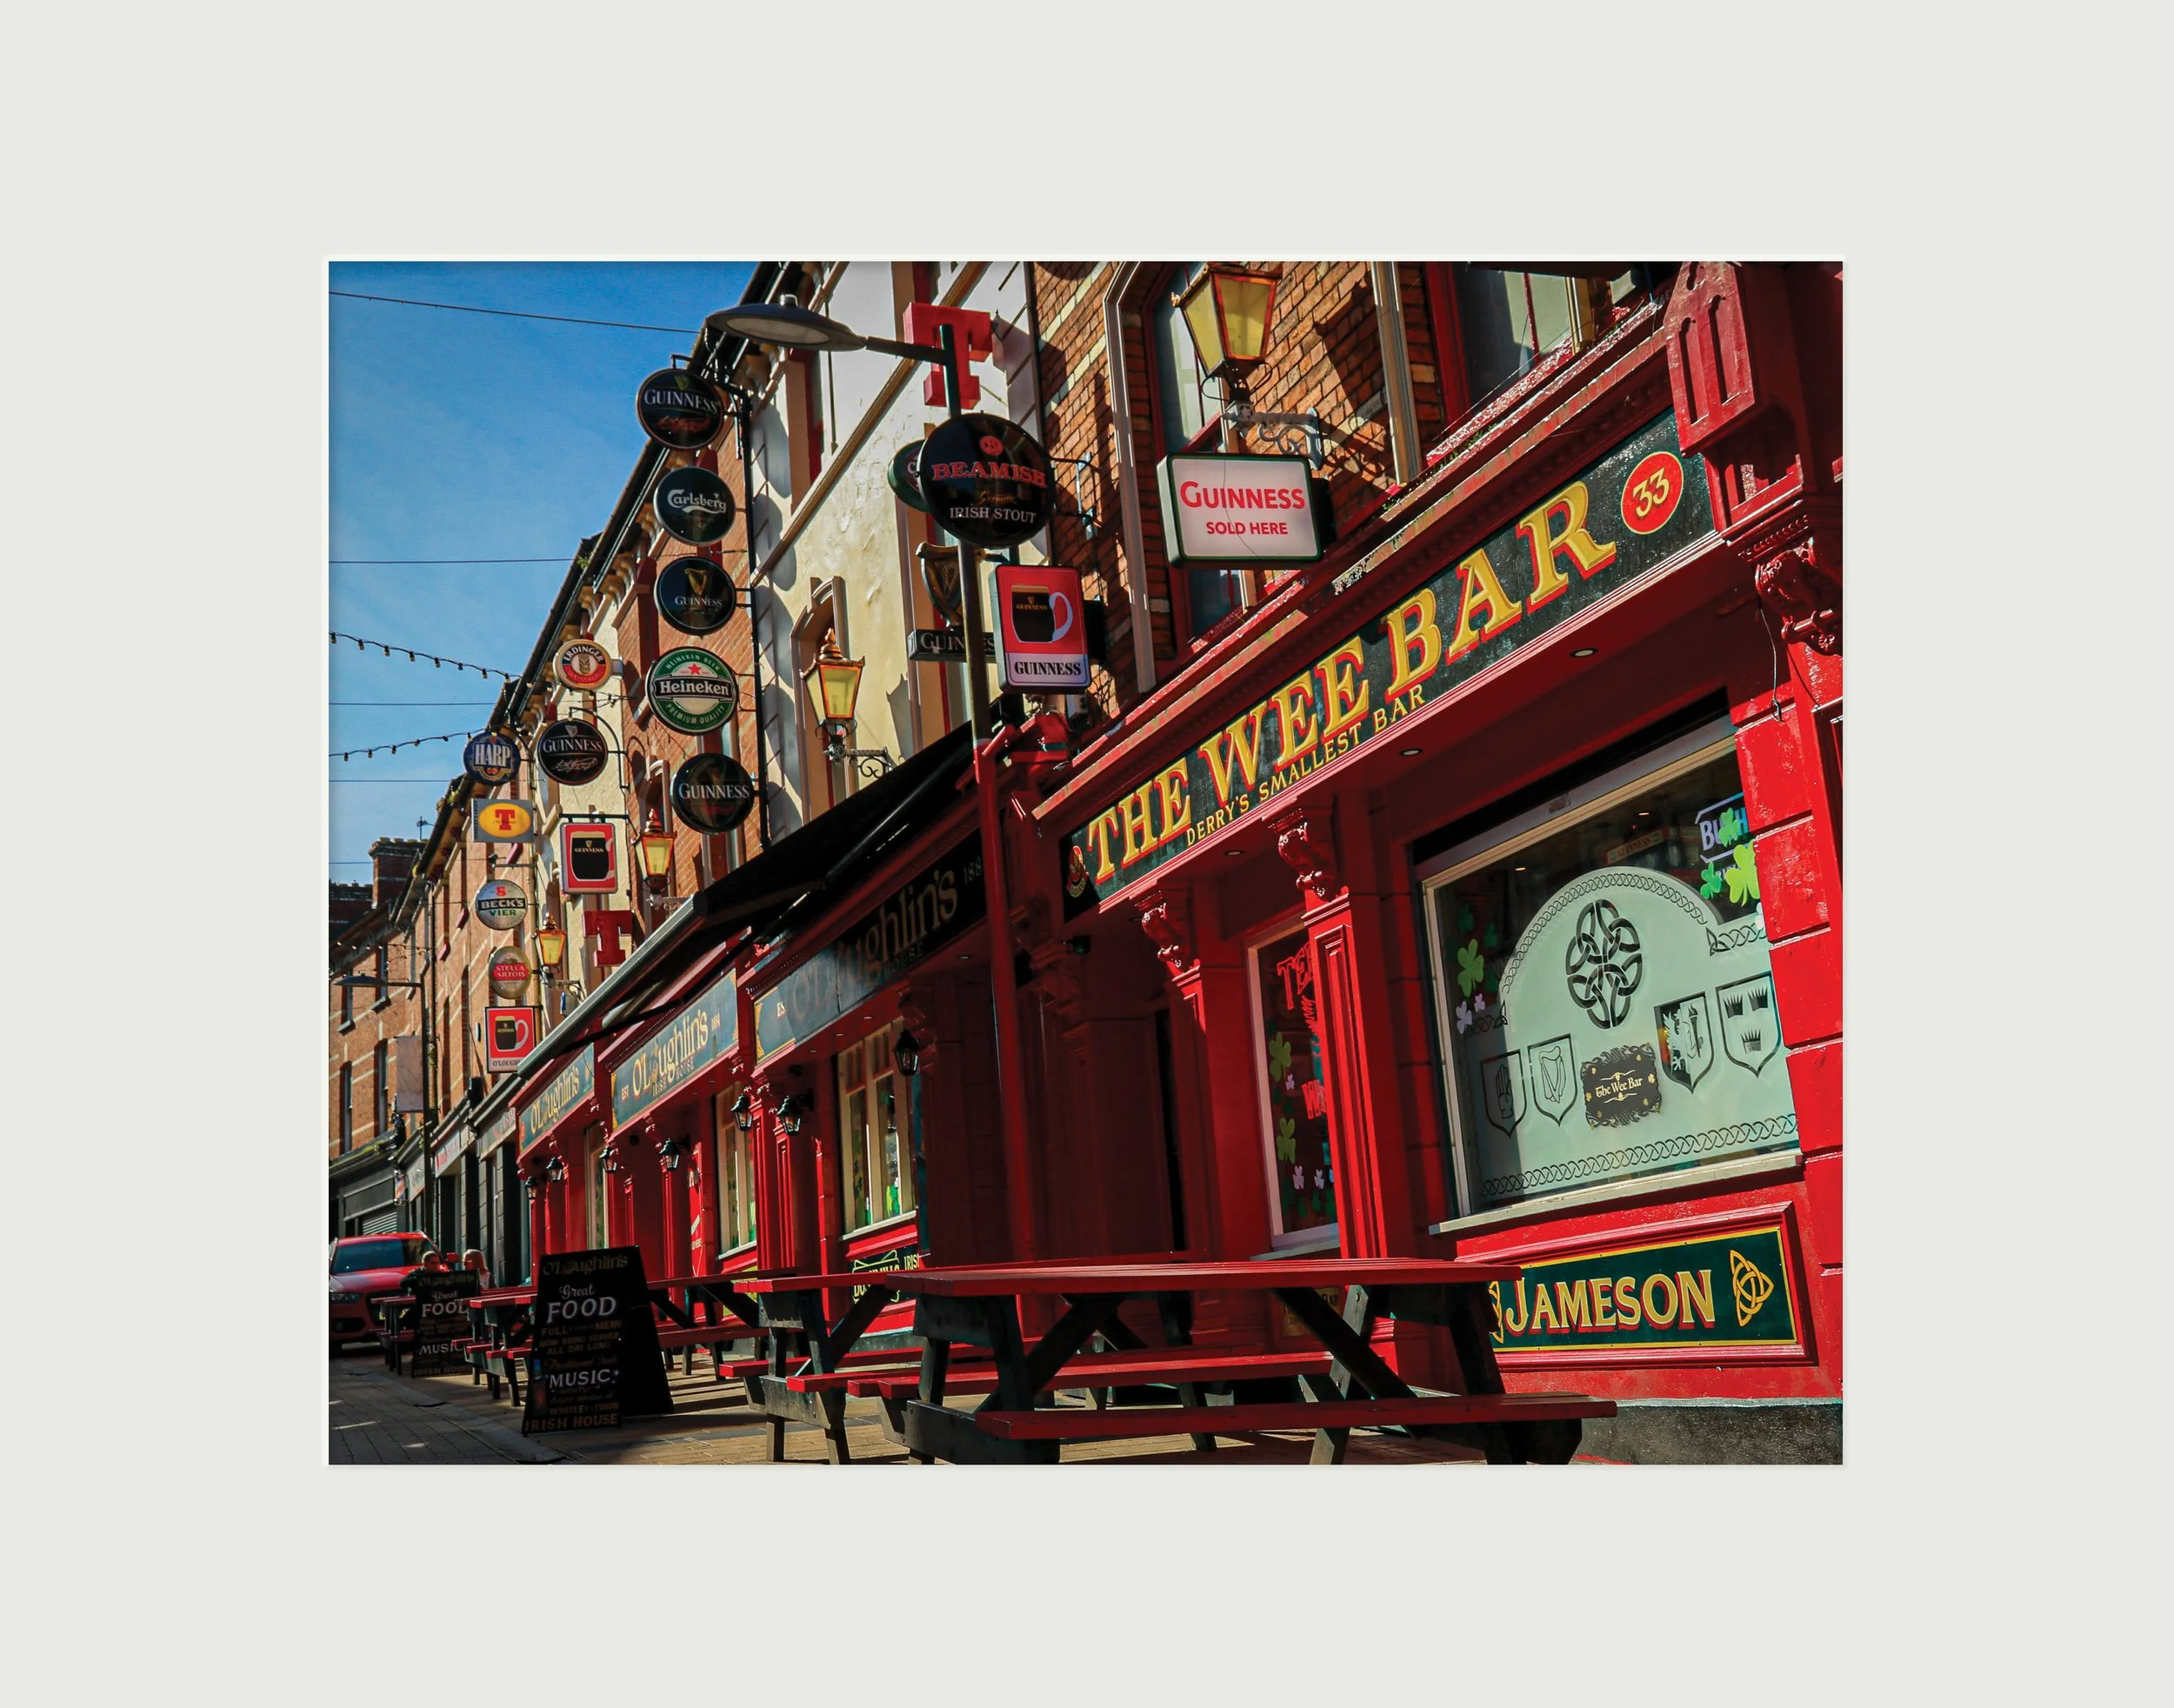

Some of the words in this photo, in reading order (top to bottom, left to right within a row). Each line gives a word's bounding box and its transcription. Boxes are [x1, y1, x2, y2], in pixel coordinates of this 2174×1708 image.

[644, 389, 718, 415] GUINNESS
[931, 461, 1047, 489] BEAMISH
[667, 489, 727, 514] Carlsberg
[1180, 481, 1305, 510] GUINNESS
[1631, 467, 1671, 518] 33
[949, 506, 990, 519] IRISH
[993, 508, 1037, 524] STOUT
[1206, 522, 1246, 535] SOLD
[1250, 522, 1288, 535] HERE
[675, 596, 723, 607] GUINNESS
[666, 654, 700, 670] HEINEKEN
[1014, 661, 1082, 677] GUINNESS
[659, 680, 729, 696] Heineken
[1087, 757, 1192, 885] THE
[1197, 635, 1370, 807] WEE
[1380, 480, 1617, 704] BAR
[665, 704, 697, 724] PREMIUM
[699, 705, 725, 724] QUALITY
[475, 744, 510, 766] HARP
[543, 739, 603, 753] GUINNESS
[1186, 793, 1250, 847] DERRY'S
[1259, 722, 1362, 802] SMALLEST
[1373, 684, 1425, 733] BAR
[678, 783, 750, 799] GUINNESS
[495, 810, 516, 831] T
[964, 857, 982, 885] 188
[481, 898, 523, 910] BECK'S
[1595, 1084, 1610, 1098] The
[1610, 1081, 1628, 1093] Wee
[1628, 1077, 1644, 1089] Bar
[559, 1283, 596, 1299] Great
[546, 1297, 617, 1324] FOOD
[1504, 1269, 1716, 1338] JAMESON
[549, 1369, 611, 1389] MUSIC
[524, 1417, 568, 1433] IRISH
[571, 1413, 619, 1429] HOUSE
